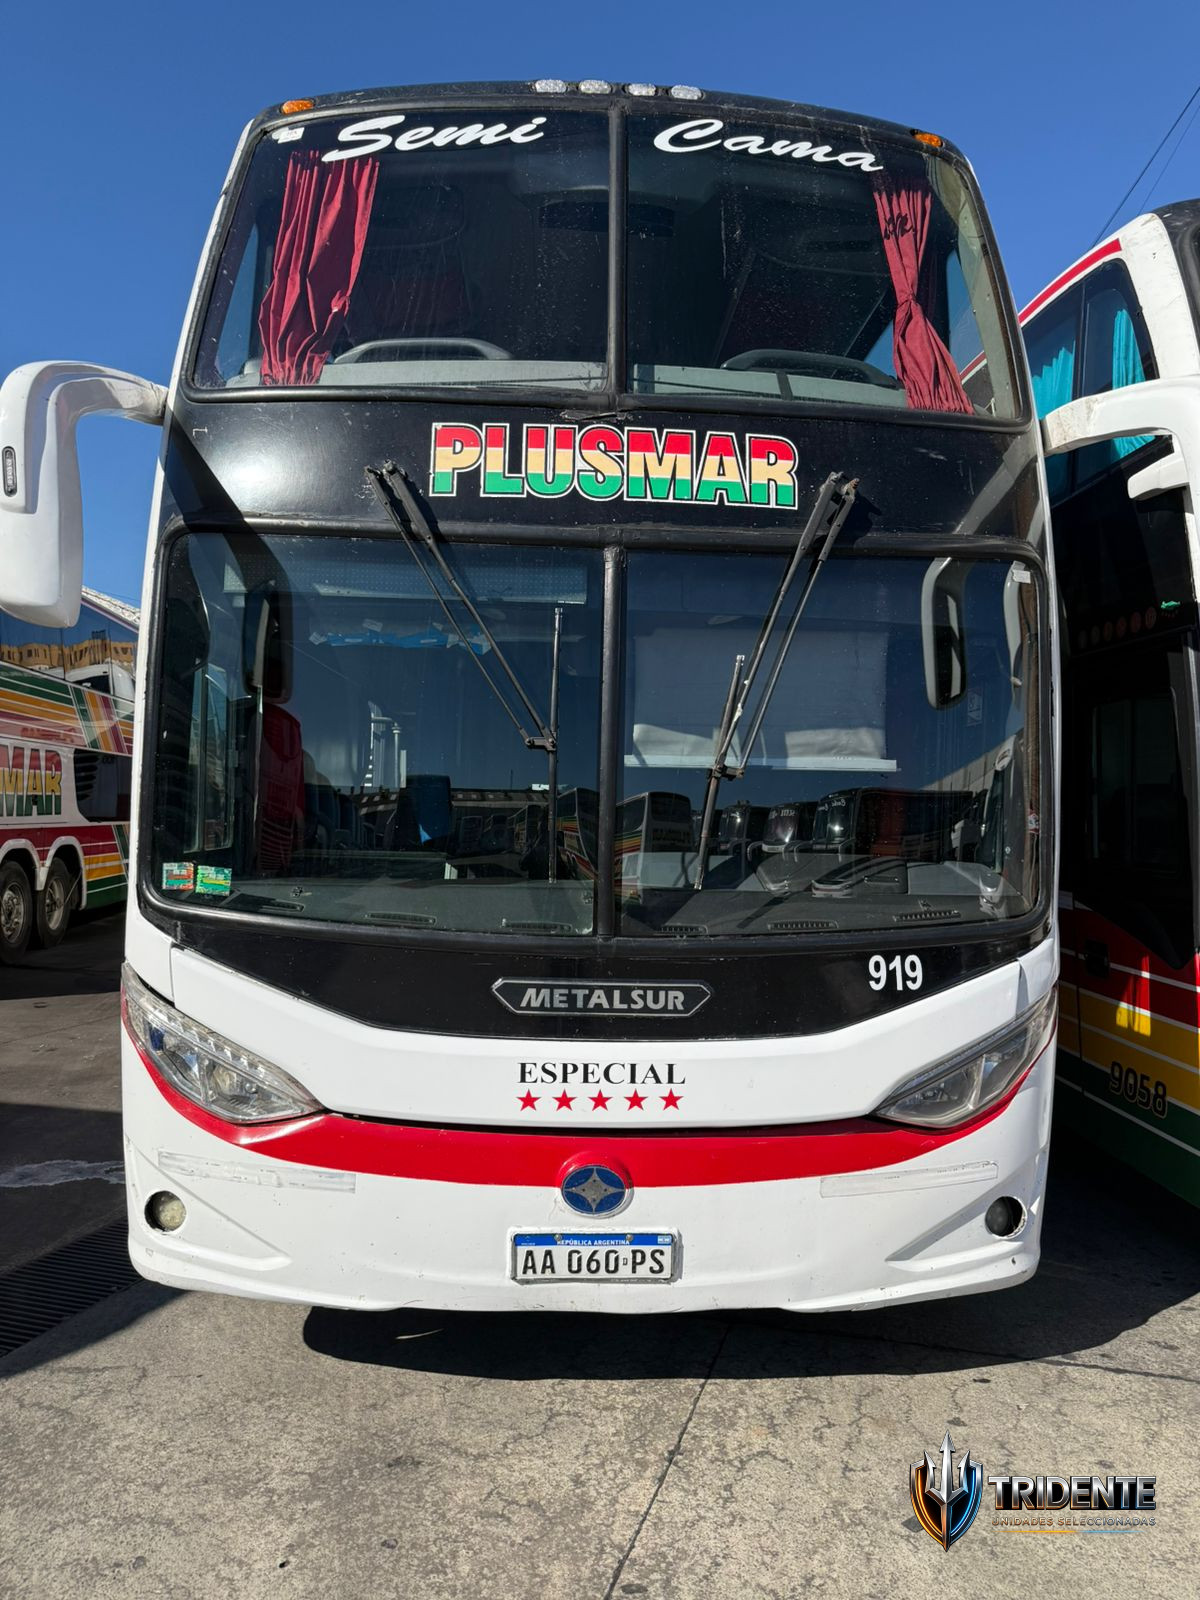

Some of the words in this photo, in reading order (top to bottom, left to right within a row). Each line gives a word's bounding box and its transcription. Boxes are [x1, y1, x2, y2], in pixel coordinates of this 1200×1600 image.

[321, 114, 547, 162] Semi
[653, 118, 884, 172] Cama
[429, 421, 799, 509] PLUSMAR
[868, 954, 923, 991] 919
[519, 987, 685, 1010] METALSUR
[517, 1062, 686, 1085] ESPECIAL
[1109, 1060, 1168, 1119] 9058
[522, 1249, 556, 1275] AA
[567, 1249, 620, 1274] 060
[631, 1249, 665, 1274] PS
